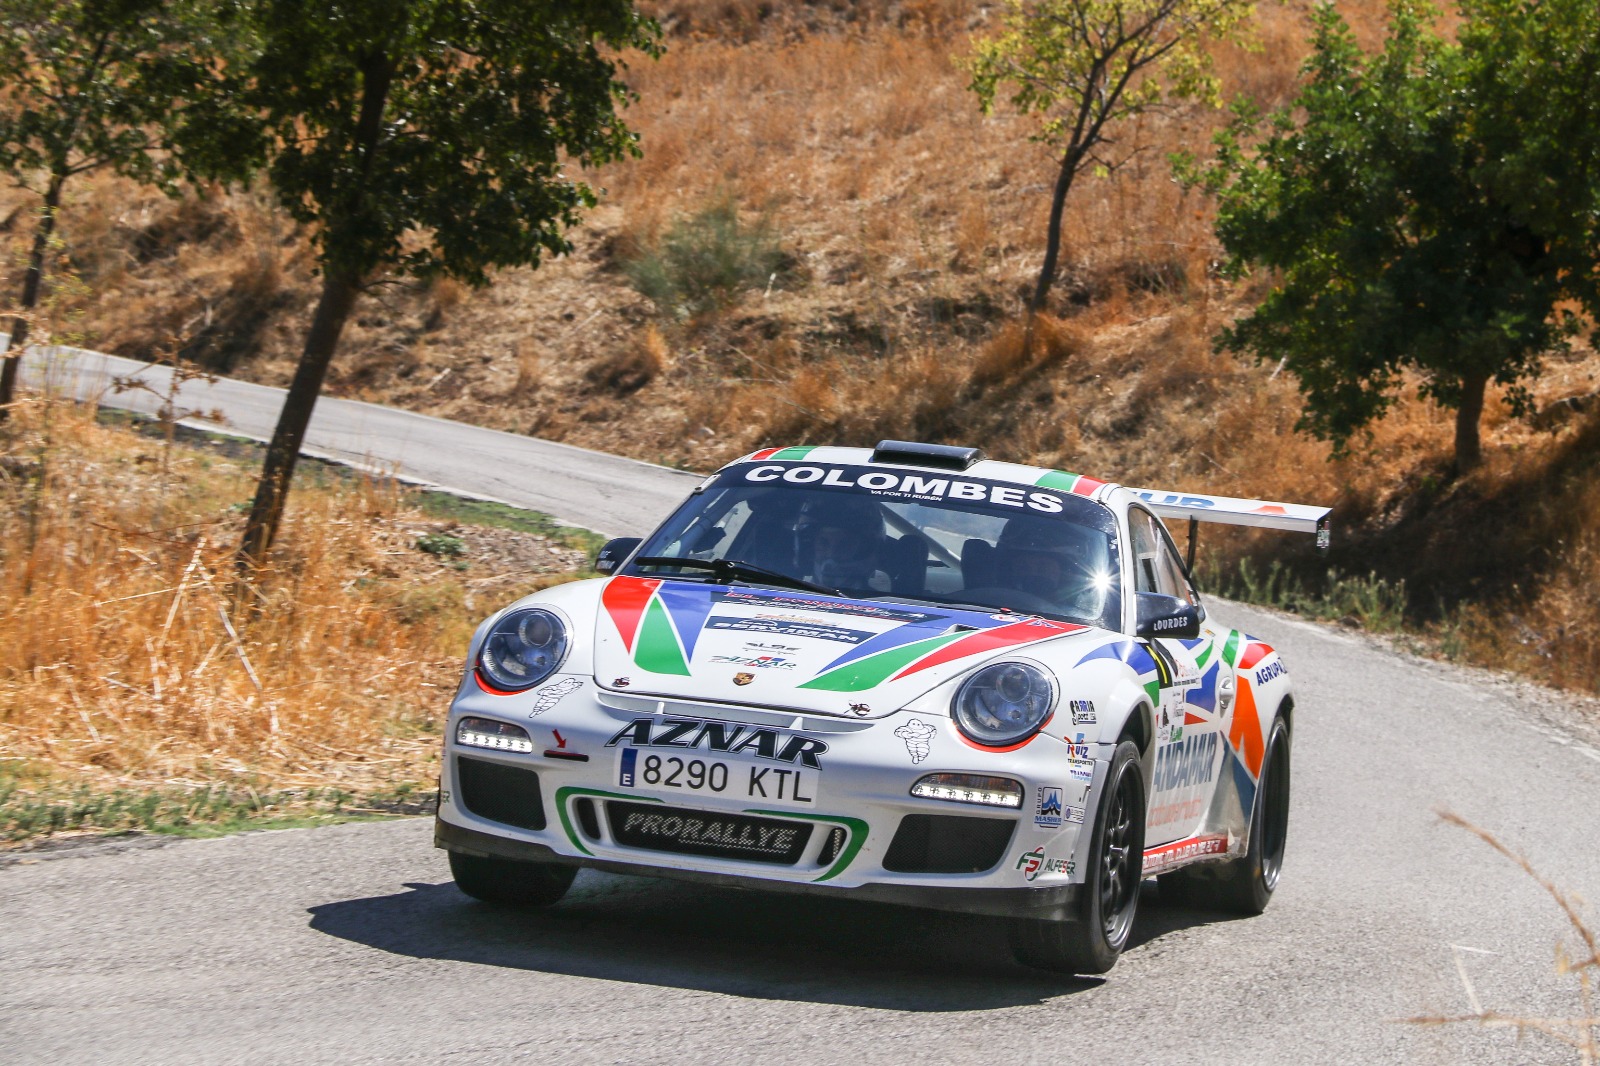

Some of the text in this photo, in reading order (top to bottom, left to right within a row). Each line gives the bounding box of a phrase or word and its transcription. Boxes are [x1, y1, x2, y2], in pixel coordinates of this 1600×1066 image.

[744, 465, 1064, 514] COLOMBES
[1153, 616, 1188, 631] LOURDES
[604, 717, 830, 771] AZNAR
[1153, 731, 1218, 793] ANDAMUR
[621, 773, 632, 785] E
[642, 754, 813, 803] 8290 KTL
[624, 812, 798, 850] PRORALLYE
[1043, 858, 1076, 875] ALFESER
